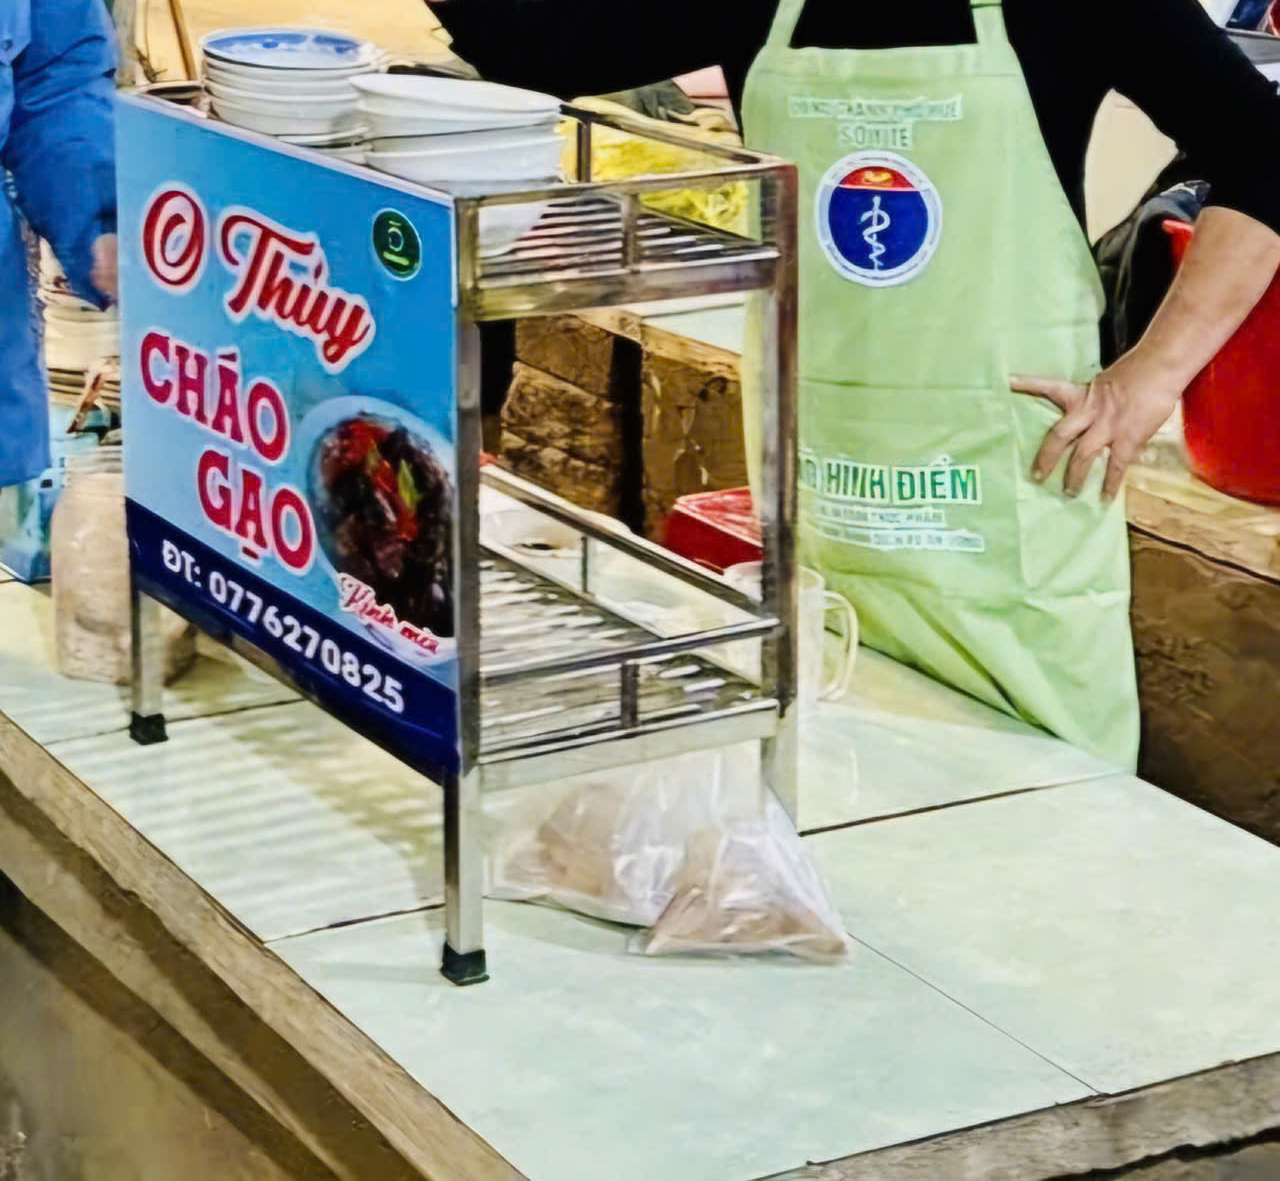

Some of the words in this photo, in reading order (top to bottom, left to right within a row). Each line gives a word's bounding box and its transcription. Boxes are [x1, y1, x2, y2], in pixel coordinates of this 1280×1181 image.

[143, 190, 205, 287] O
[221, 215, 371, 364] Thúy
[140, 331, 289, 462] CHÁO
[197, 449, 314, 570] GẠO
[161, 538, 202, 588] ĐT:
[208, 570, 406, 715] 0776270825
